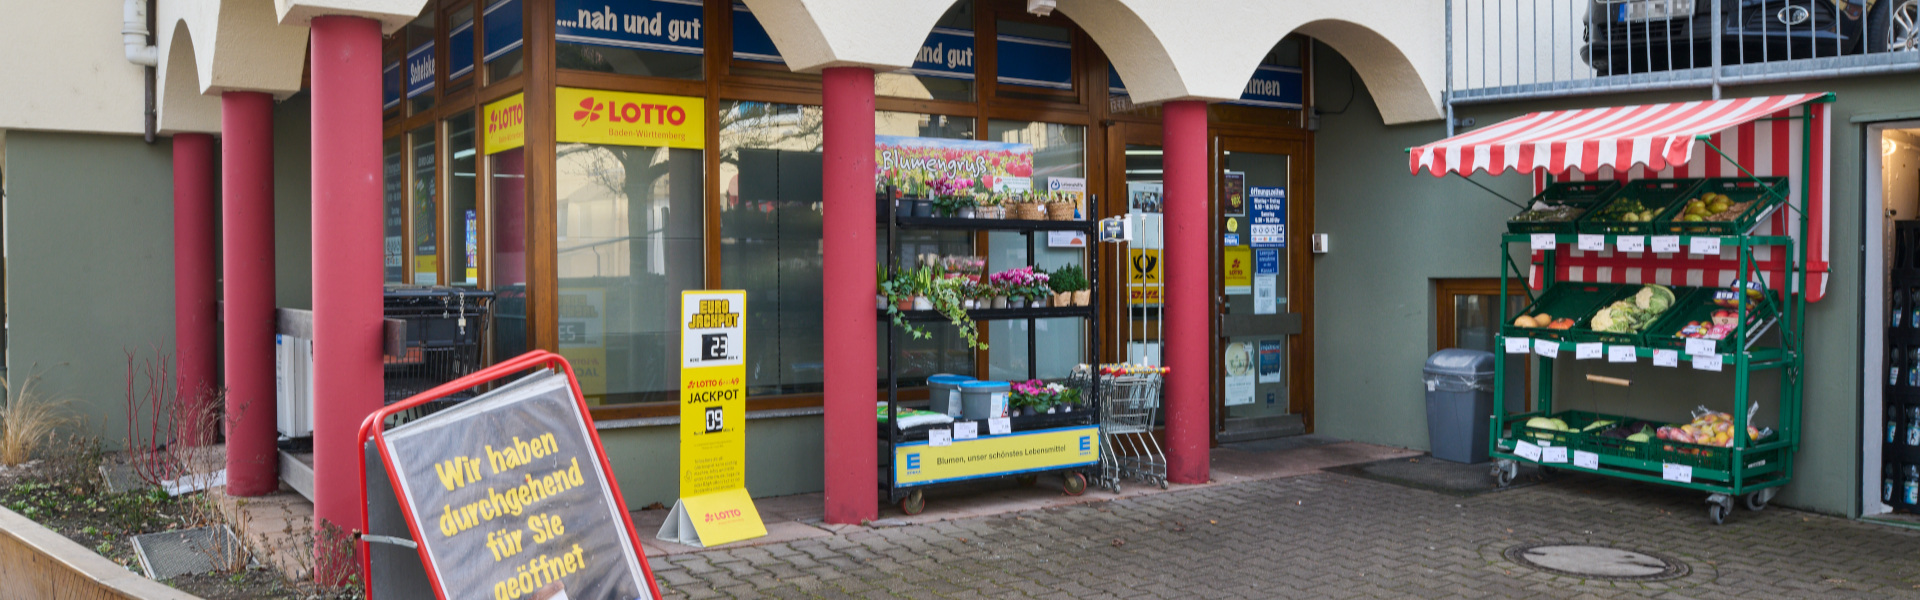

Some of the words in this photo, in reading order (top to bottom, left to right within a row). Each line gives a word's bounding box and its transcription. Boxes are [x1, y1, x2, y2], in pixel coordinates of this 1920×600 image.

[624, 12, 662, 37] und
[668, 18, 701, 42] gut
[411, 54, 436, 85] Schelske
[947, 47, 973, 69] gut
[499, 103, 524, 131] LOTTO
[609, 100, 686, 126] LOTTO
[609, 128, 686, 141] Baden-Württemberg
[882, 149, 987, 179] Blumengruß
[699, 299, 730, 315] EURO
[688, 312, 740, 329] JACKPOT
[711, 336, 728, 358] 23
[697, 379, 717, 389] LOTTO
[688, 389, 740, 404] JACKPOT
[705, 408, 723, 431] 09
[435, 457, 482, 491] Wir
[485, 432, 559, 475] haben
[936, 456, 966, 466] Blumen,
[967, 453, 987, 463] unser
[988, 450, 1023, 460] schönstes
[1024, 445, 1066, 457] Lebensmittel
[439, 457, 584, 537] durchgehend
[714, 508, 742, 521] LOTTO
[486, 528, 523, 562] für
[527, 513, 564, 545] Sie
[494, 543, 586, 600] geöffnet
